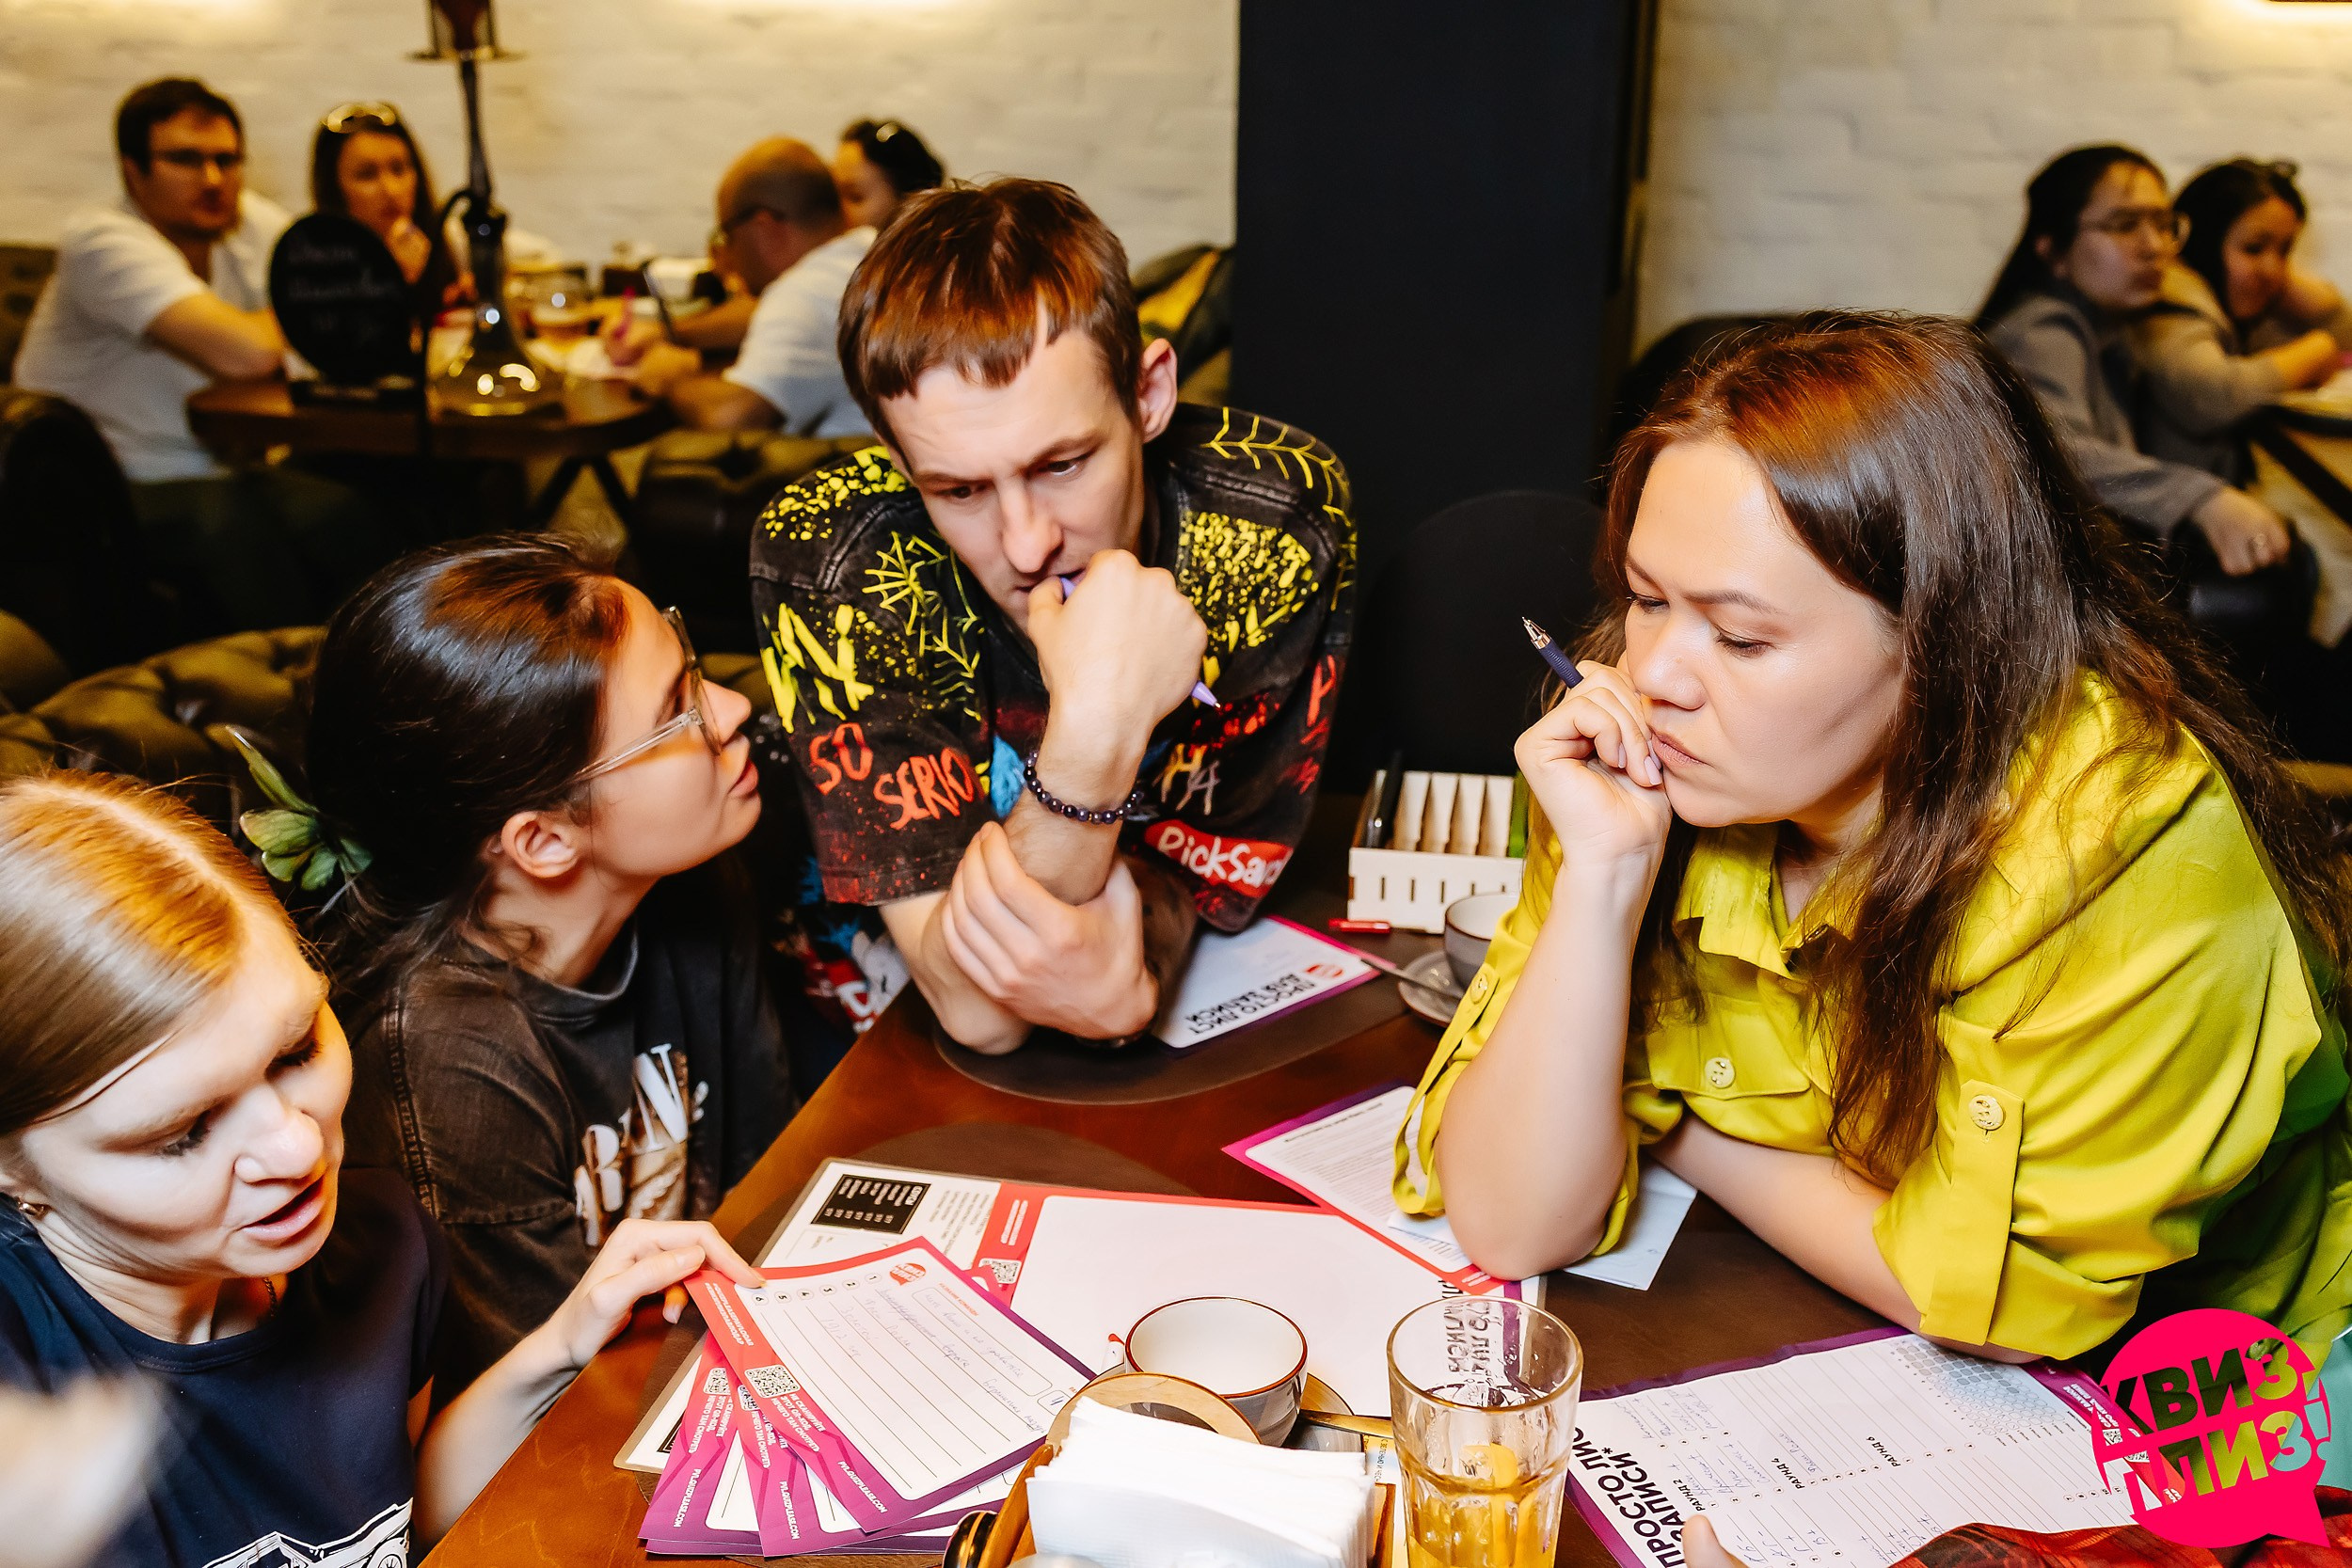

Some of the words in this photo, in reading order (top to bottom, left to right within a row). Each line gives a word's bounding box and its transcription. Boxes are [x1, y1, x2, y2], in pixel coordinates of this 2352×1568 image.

[1872, 1441, 1901, 1468] РАУНД
[1776, 1462, 1805, 1490] РАУНД
[1678, 1485, 1706, 1512] РАУНД
[1597, 1475, 1685, 1568] ПРОСТО
